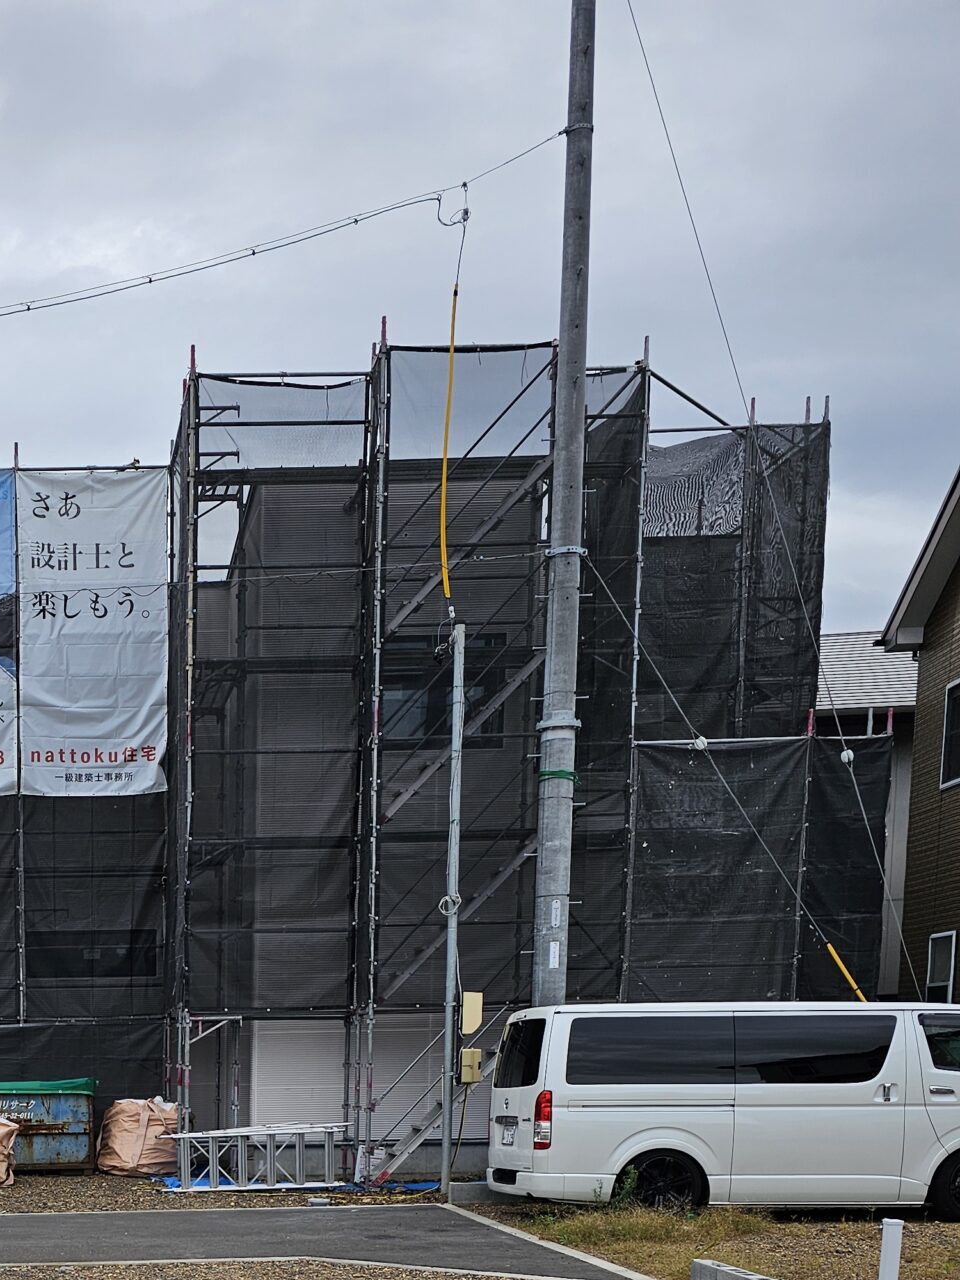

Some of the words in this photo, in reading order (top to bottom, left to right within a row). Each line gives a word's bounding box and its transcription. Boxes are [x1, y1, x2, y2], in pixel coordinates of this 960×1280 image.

[31, 492, 81, 520] さあ
[31, 541, 136, 572] 設計士と
[31, 592, 151, 621] 楽しもう。
[30, 745, 157, 764] nattoku住宅
[54, 771, 134, 783] 一級建築士事務所
